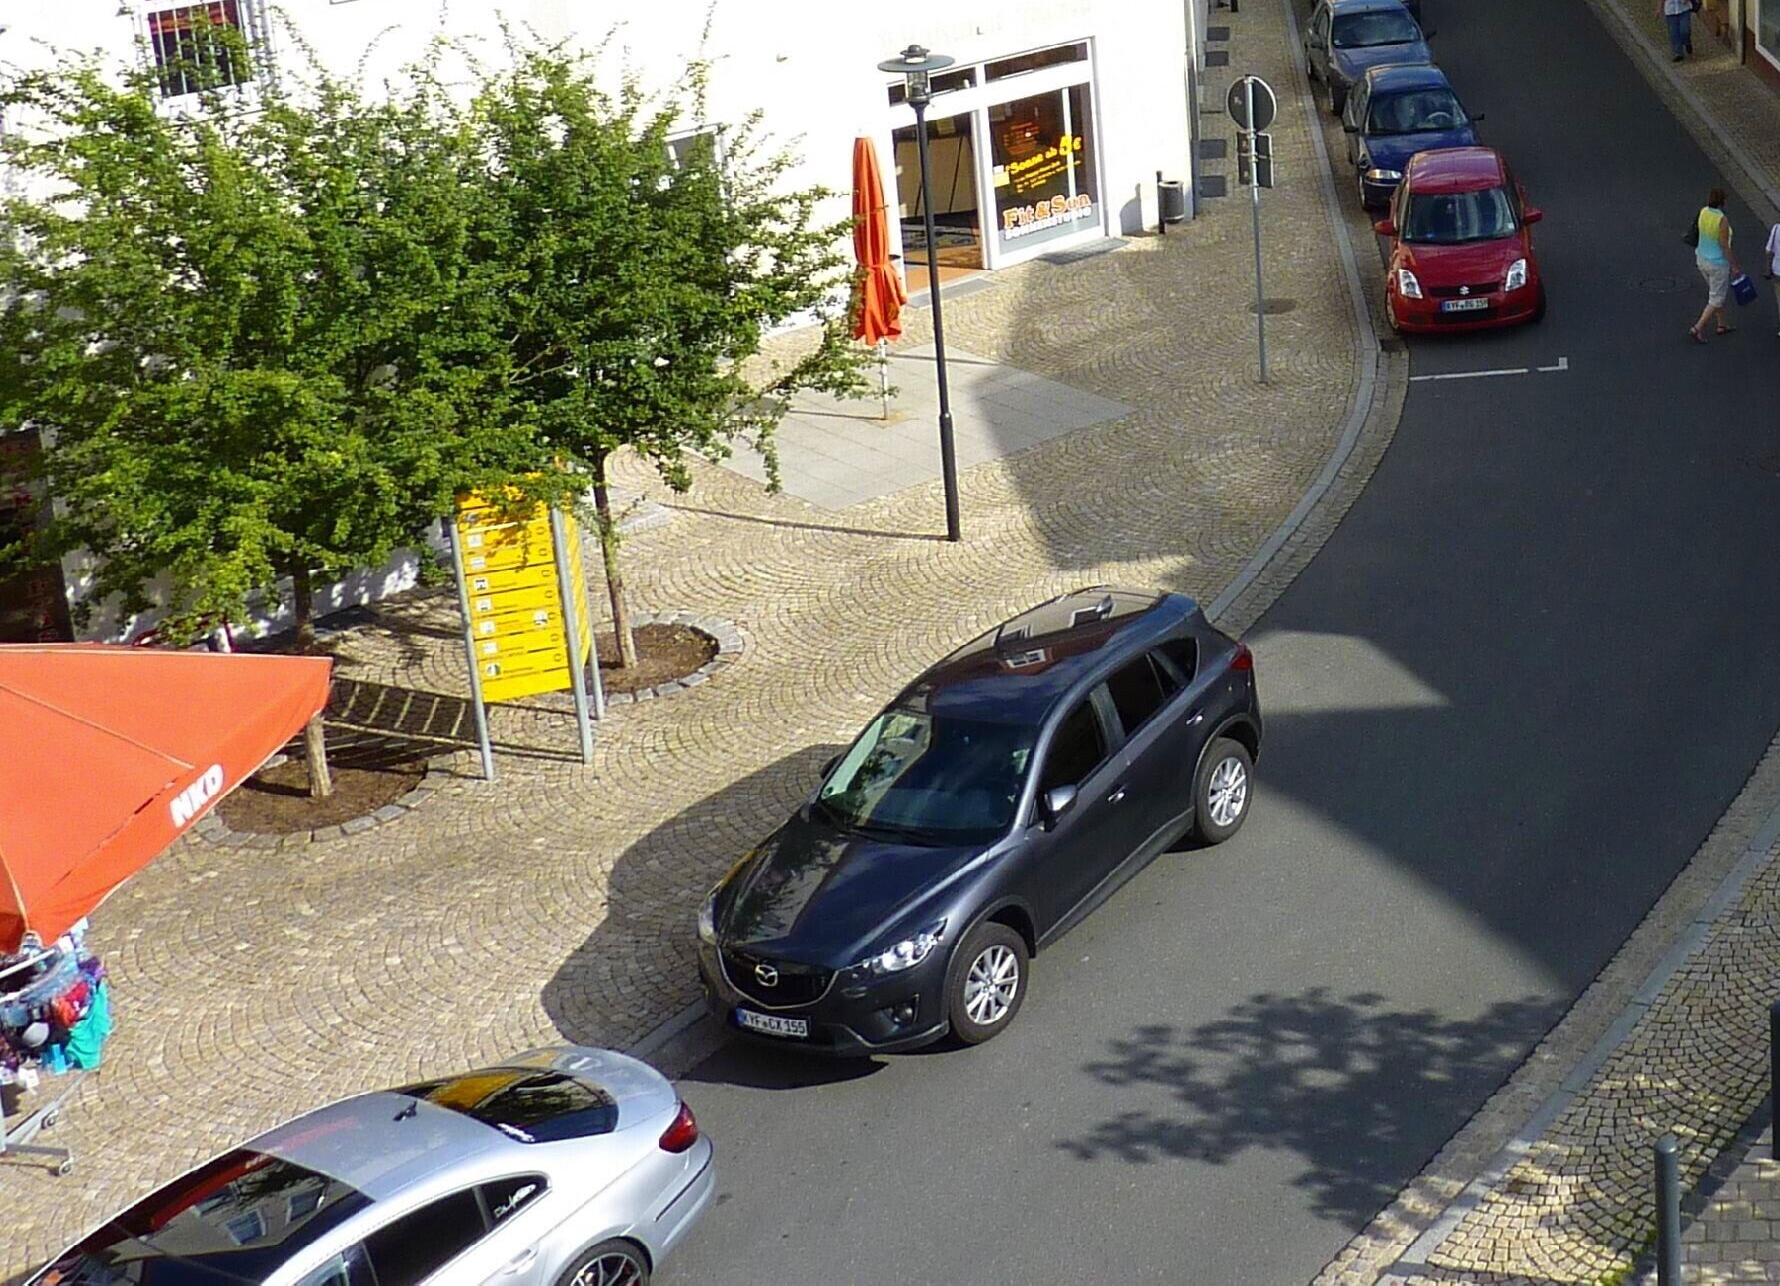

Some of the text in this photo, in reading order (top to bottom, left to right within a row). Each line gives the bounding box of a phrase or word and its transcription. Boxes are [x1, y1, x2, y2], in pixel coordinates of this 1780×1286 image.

[1003, 194, 1092, 229] Fit & Sun
[169, 763, 225, 829] NKD
[783, 1020, 806, 1034] 155
